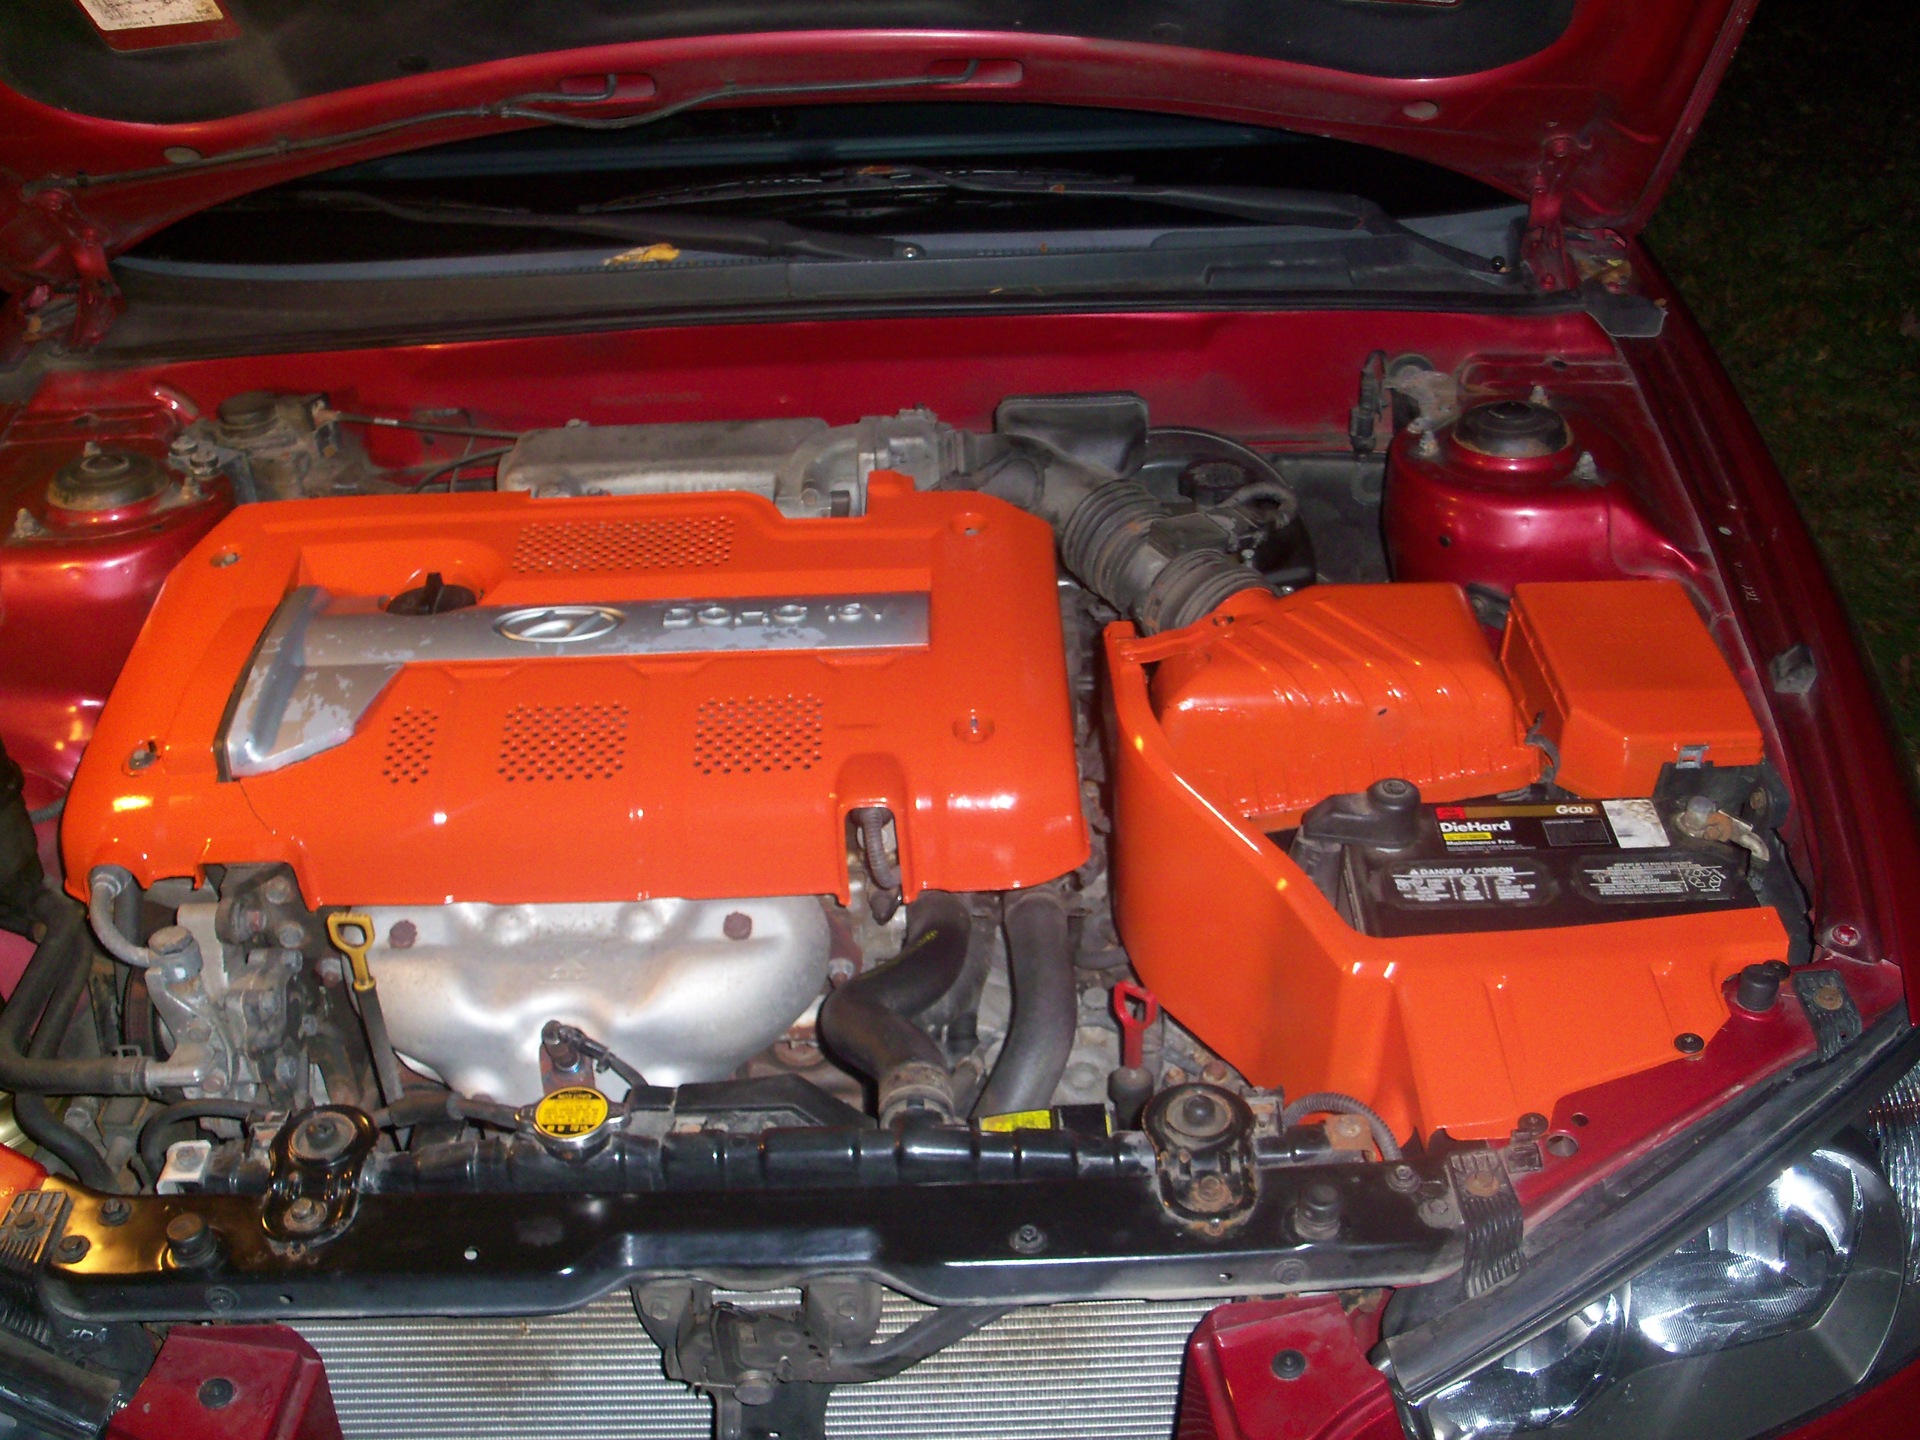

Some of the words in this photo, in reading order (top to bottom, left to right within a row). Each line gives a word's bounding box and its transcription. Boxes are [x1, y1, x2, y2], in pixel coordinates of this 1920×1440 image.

[662, 603, 808, 628] DOHC
[1439, 820, 1511, 832] DieHard
[1419, 868, 1464, 876] DANGER
[1474, 867, 1514, 875] POISON
